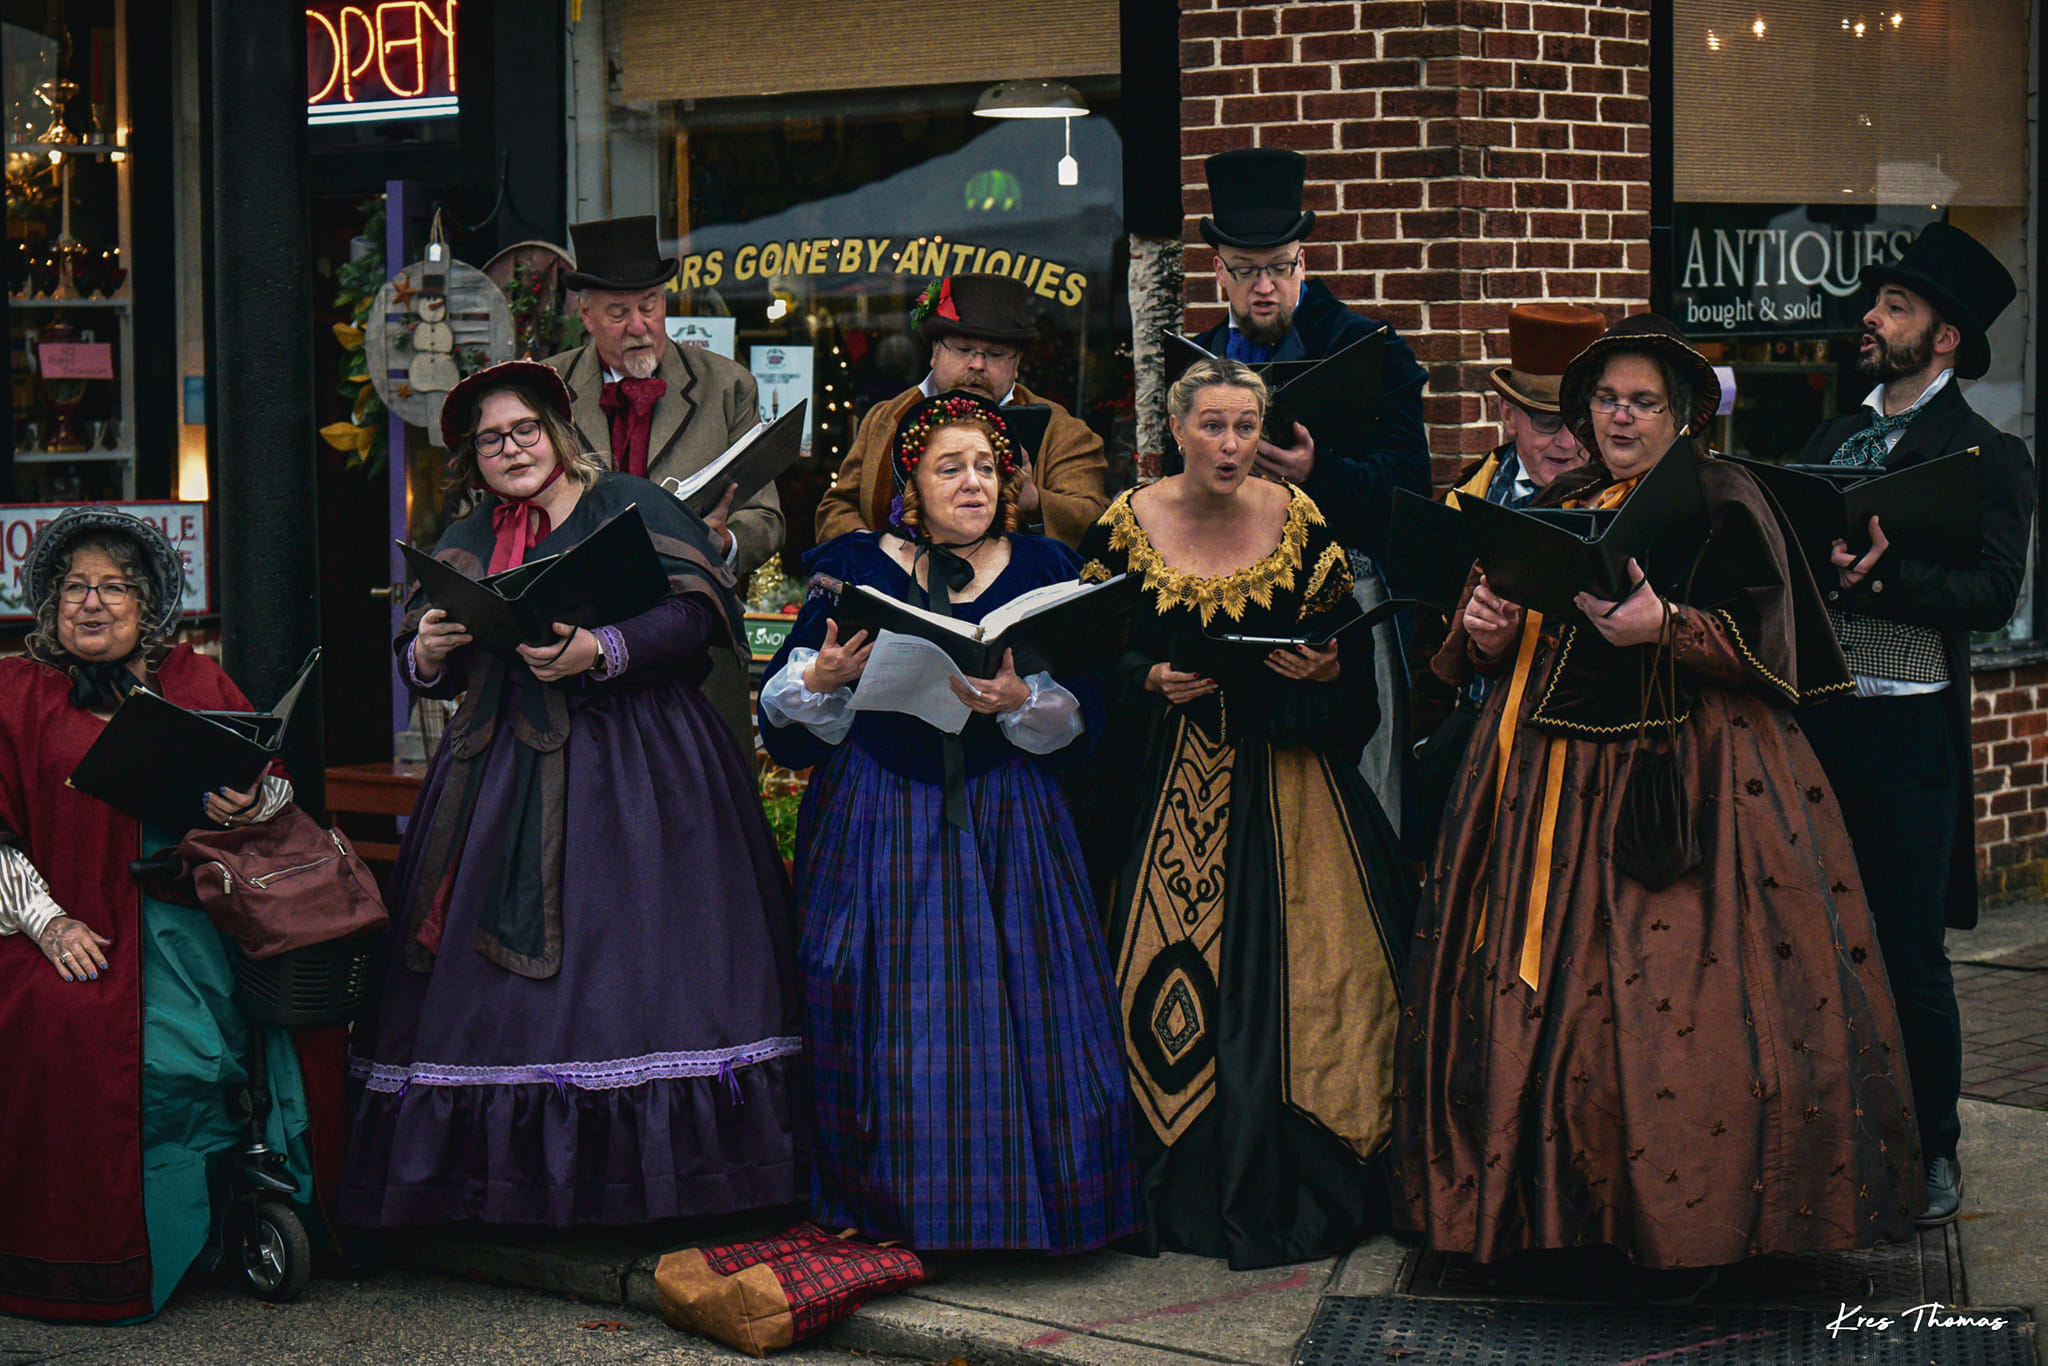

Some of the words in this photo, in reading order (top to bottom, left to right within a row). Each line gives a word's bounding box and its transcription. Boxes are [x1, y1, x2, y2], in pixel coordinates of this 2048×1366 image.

[734, 239, 831, 281] GONE
[838, 239, 891, 273] BY
[895, 240, 1088, 307] ANTIQUES
[1687, 296, 1754, 329] bought
[1759, 296, 1778, 321] &
[1783, 294, 1822, 320] sold
[755, 628, 786, 646] SNO
